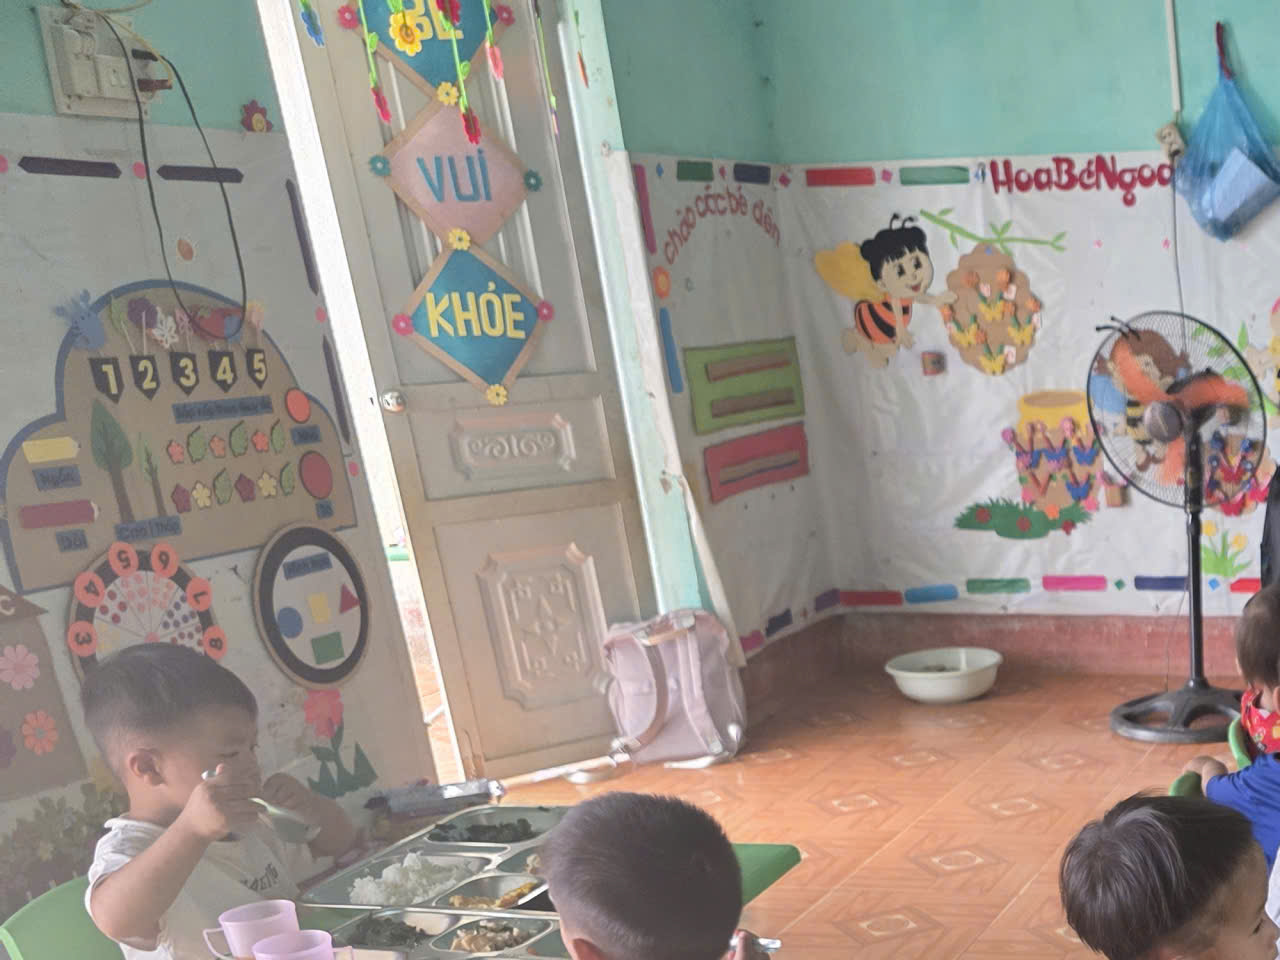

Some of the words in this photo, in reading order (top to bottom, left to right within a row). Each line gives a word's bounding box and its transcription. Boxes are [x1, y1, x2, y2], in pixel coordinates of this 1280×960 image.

[101, 363, 119, 395] 1
[138, 359, 158, 390] 2
[178, 357, 197, 387] 3
[215, 356, 235, 385] 4
[252, 352, 268, 382] 5
[84, 578, 100, 597] 4
